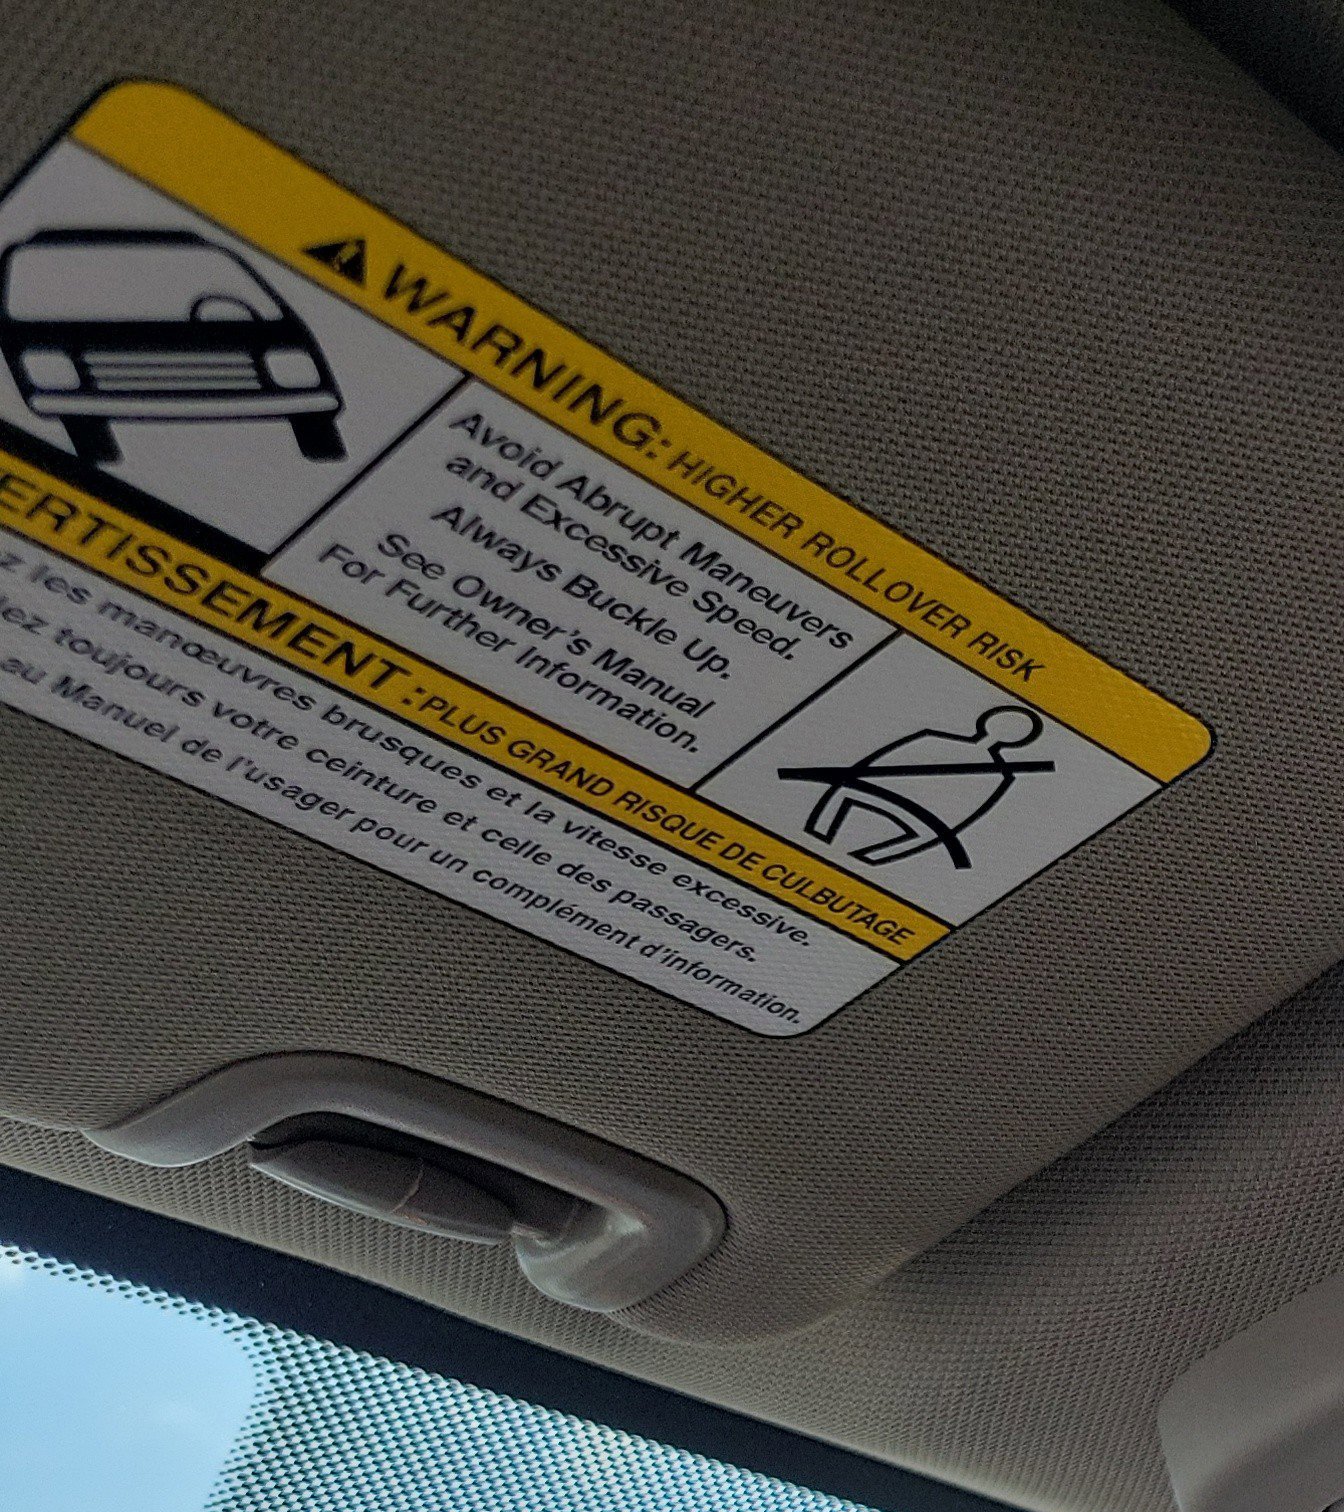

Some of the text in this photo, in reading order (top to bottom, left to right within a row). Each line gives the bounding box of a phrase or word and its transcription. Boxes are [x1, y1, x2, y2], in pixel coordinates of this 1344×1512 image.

[382, 264, 1048, 684] WARNING: HIGHER ROLLOVER RISK
[430, 506, 733, 681] Always Buckle Up.
[446, 452, 797, 664] and Excessive Speed.
[448, 412, 855, 651] Avoid Abrupt Maneuvers
[319, 542, 703, 754] For Further Information.
[377, 531, 717, 719] See Owner's Manual
[0, 658, 802, 1025] au Manuel de l'usager pour un complément d'information.
[29, 565, 94, 605] les
[320, 703, 483, 789] brusques
[485, 780, 523, 808] et
[523, 799, 557, 826] la
[562, 817, 671, 878] vitesse
[670, 865, 812, 948] excessive.
[54, 628, 206, 710] toujours
[210, 702, 301, 752] votre
[304, 744, 438, 815] ceinture
[442, 808, 479, 832] et
[480, 828, 553, 868] celle
[555, 856, 611, 896] des
[608, 884, 758, 966] passagers.
[418, 694, 507, 746] PLUS
[507, 739, 616, 797] GRAND
[613, 790, 720, 853] RISQUE
[719, 840, 765, 873] DE
[761, 862, 917, 947] CULBUTAGE
